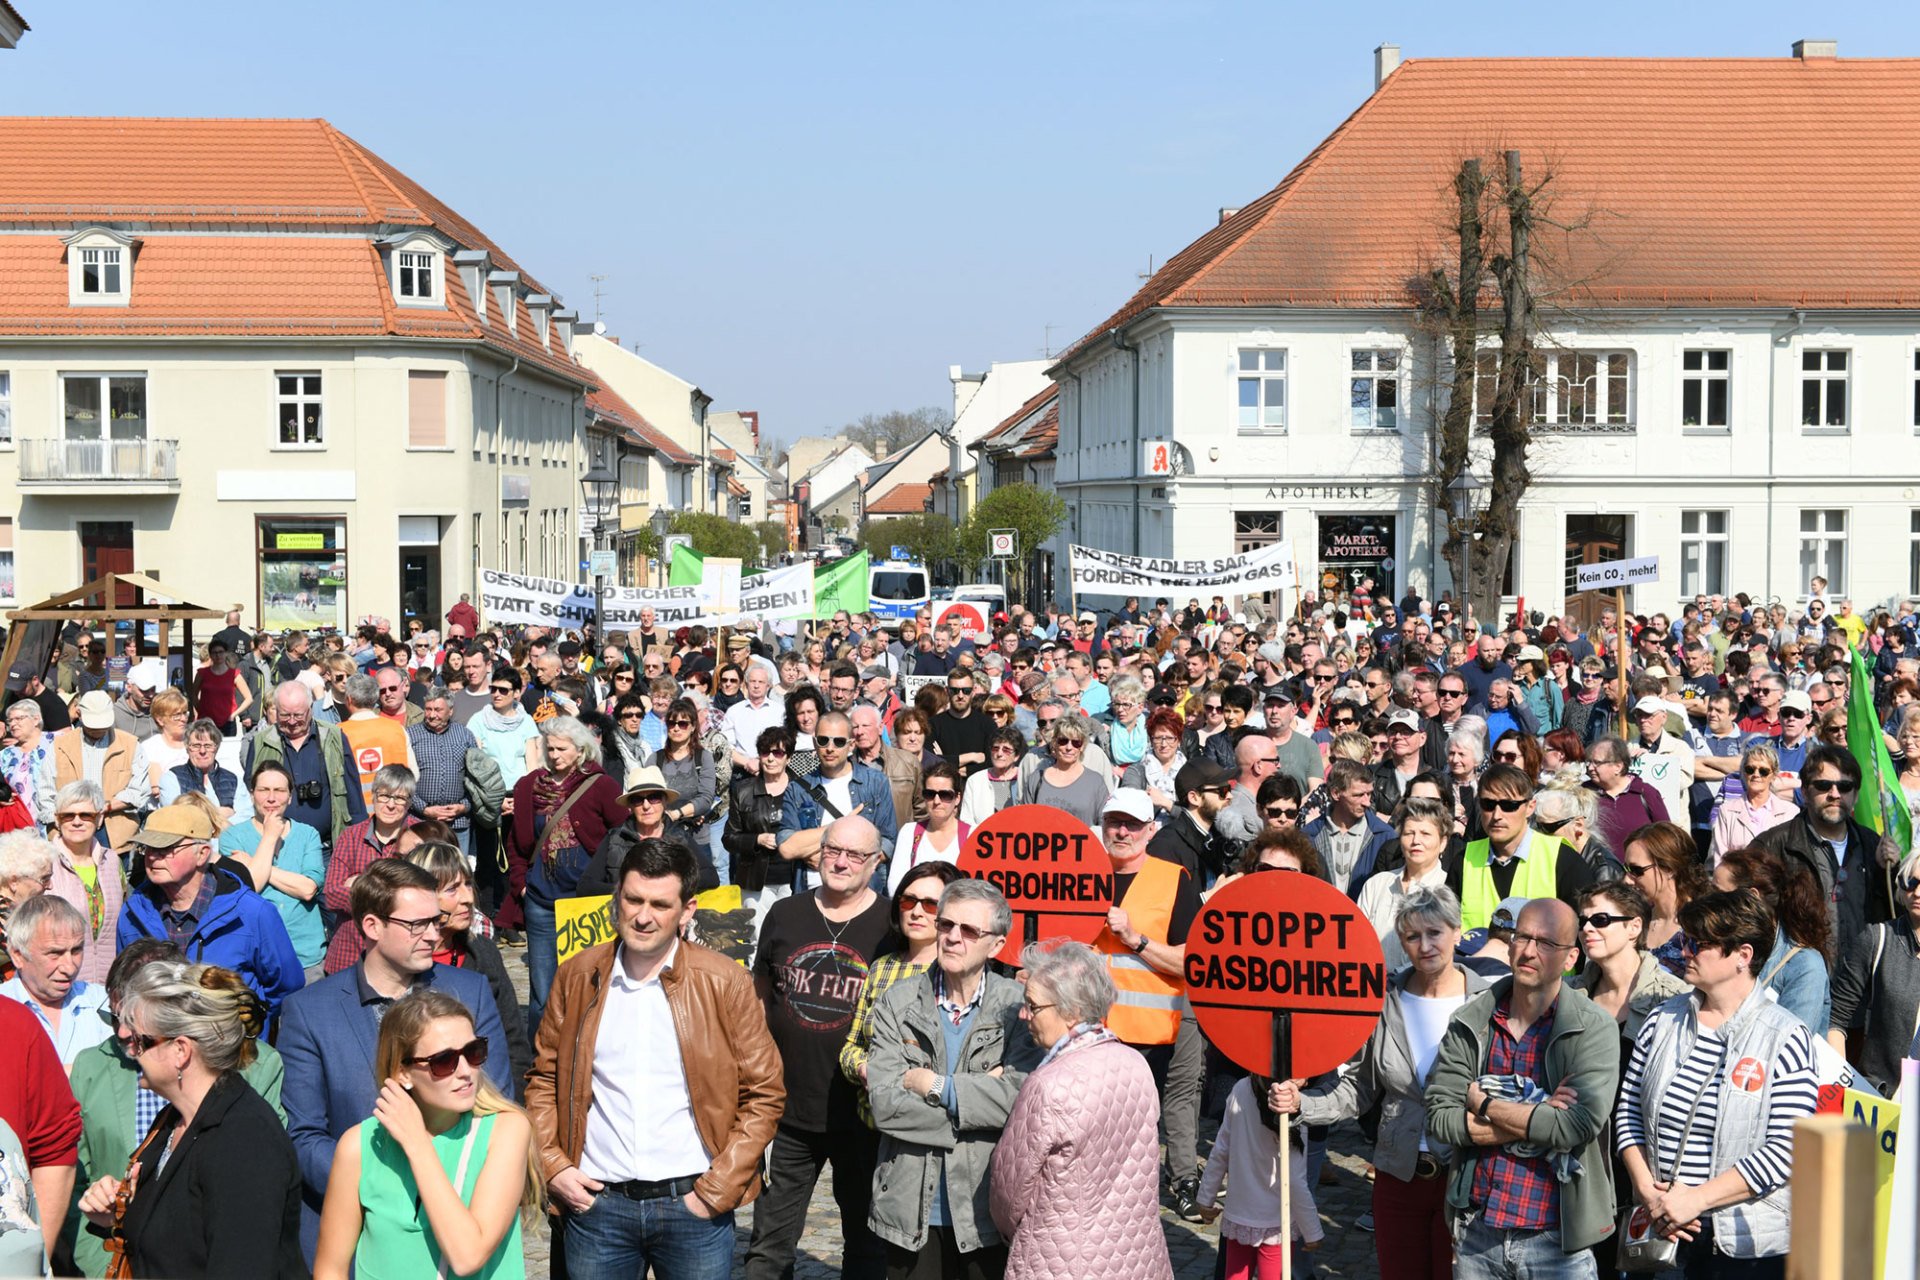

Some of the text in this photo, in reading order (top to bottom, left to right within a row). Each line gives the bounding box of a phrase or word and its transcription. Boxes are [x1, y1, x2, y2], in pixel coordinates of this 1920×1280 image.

[1265, 486, 1373, 499] APOTHEKE
[1325, 546, 1388, 557] APOTHEKE
[1333, 535, 1380, 546] MARKT-
[1073, 565, 1153, 586] FÖRDERT
[1196, 574, 1240, 587] KEIN
[1244, 562, 1283, 582] GAS
[1105, 553, 1143, 570] DER
[1146, 559, 1207, 575] ADLER
[1579, 571, 1601, 583] Kein
[1628, 563, 1657, 577] mehr!
[483, 570, 567, 595] GESUND
[623, 586, 696, 600] SICHER
[483, 593, 535, 613] STATT
[975, 830, 1089, 862] STOPPT
[556, 902, 616, 956] JASPE
[1203, 909, 1354, 950] STOPPT
[1184, 953, 1384, 999] GASBOHREN
[1816, 1065, 1855, 1110] rung!
